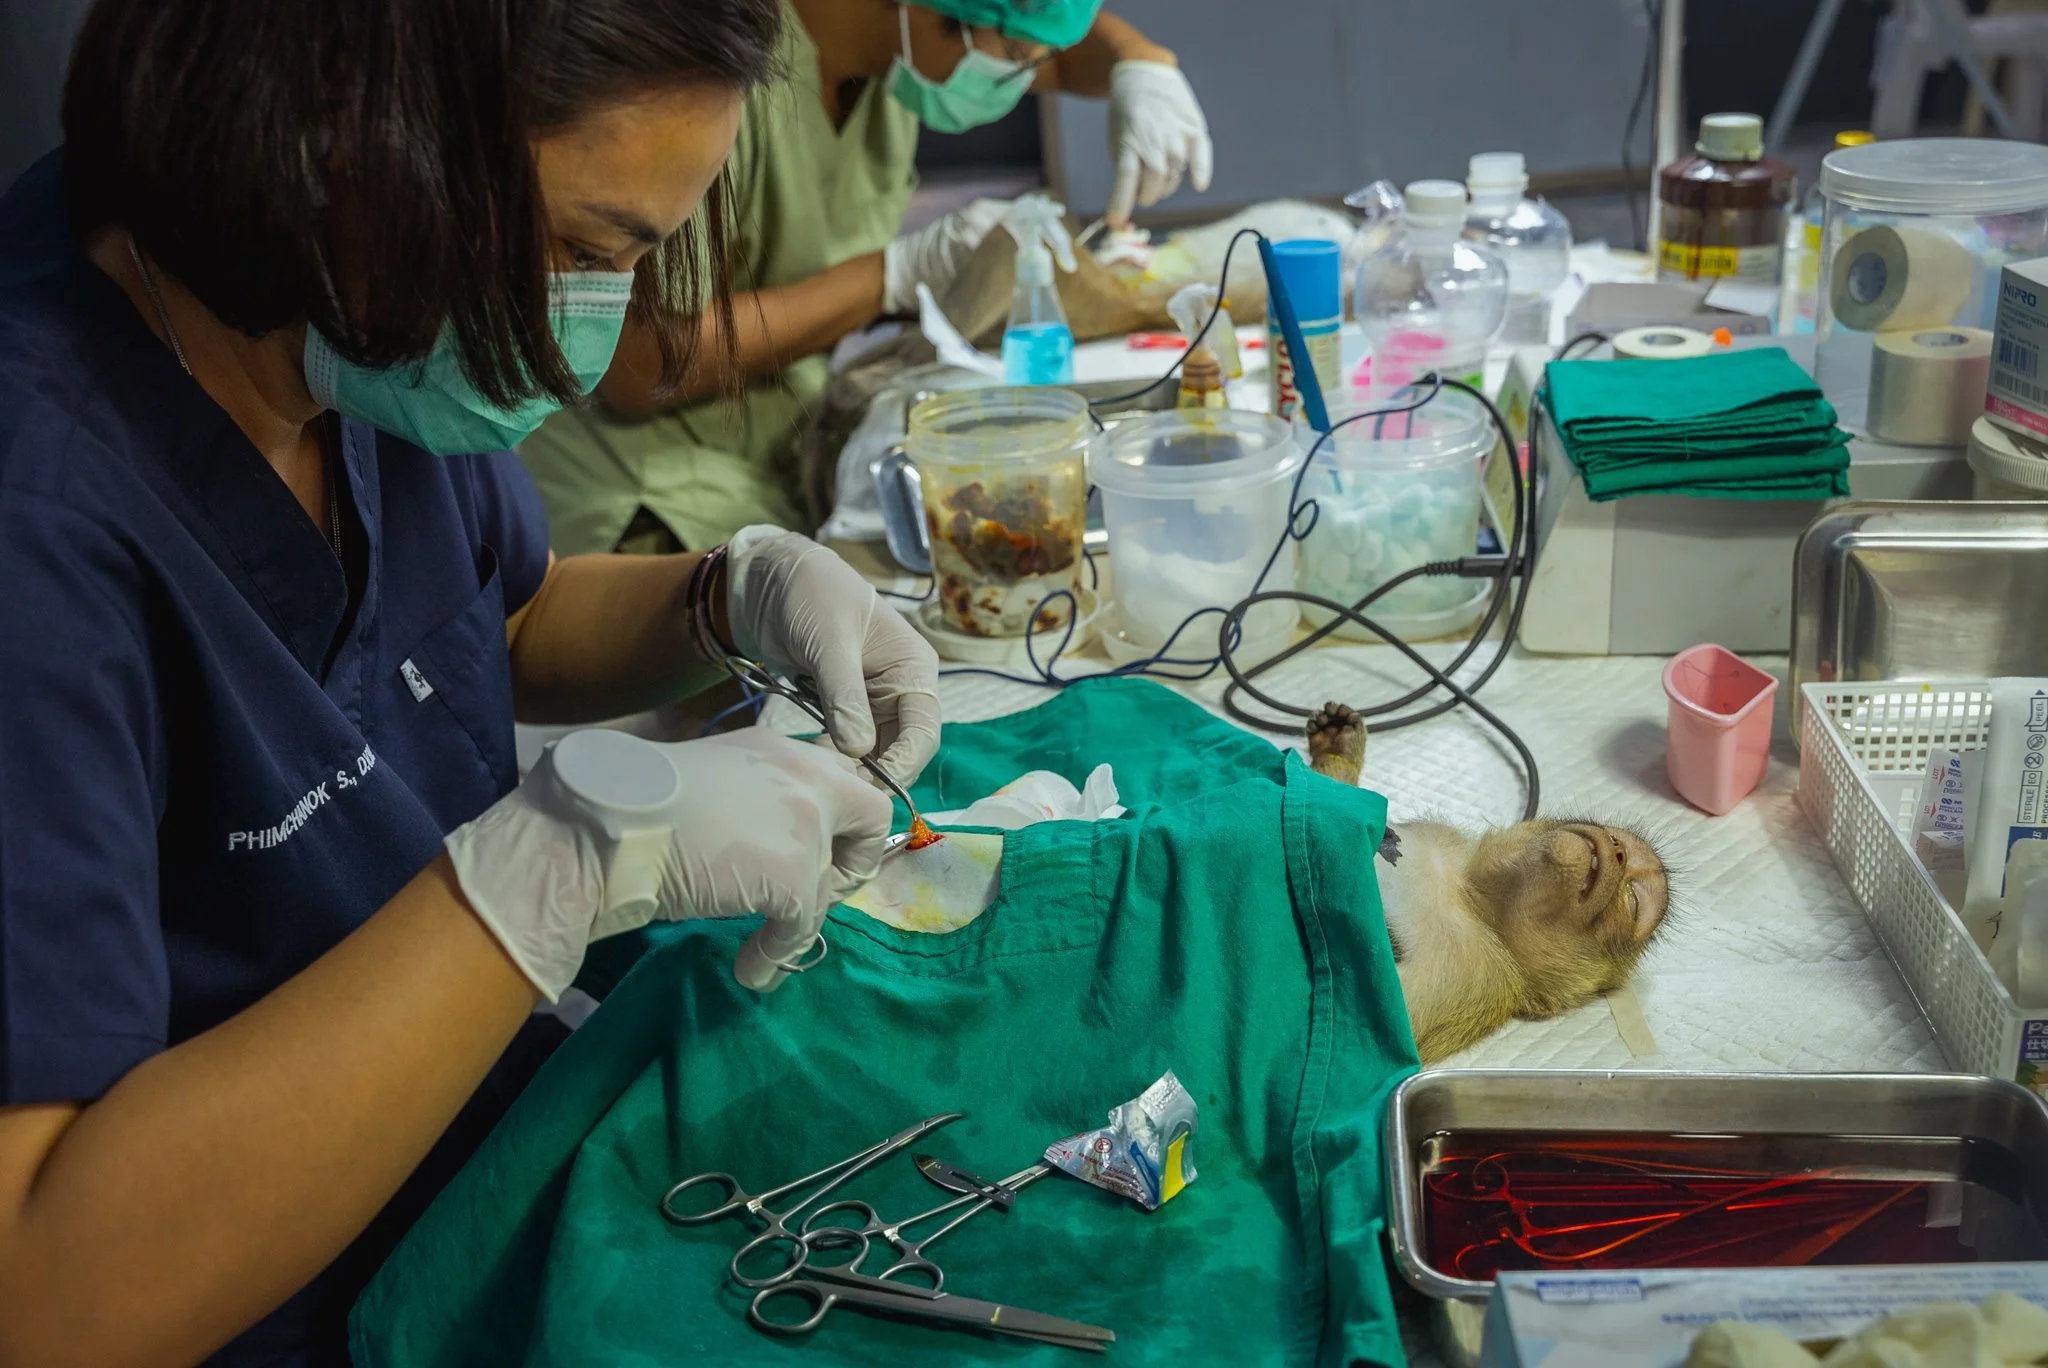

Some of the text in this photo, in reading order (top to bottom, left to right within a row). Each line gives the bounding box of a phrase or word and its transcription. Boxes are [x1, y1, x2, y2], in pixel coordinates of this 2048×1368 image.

[2003, 281, 2037, 307] NIPRO
[2035, 701, 2044, 721] PEEL
[2023, 772, 2037, 821] STERILE EO
[228, 782, 331, 851] PHIMCHANOK
